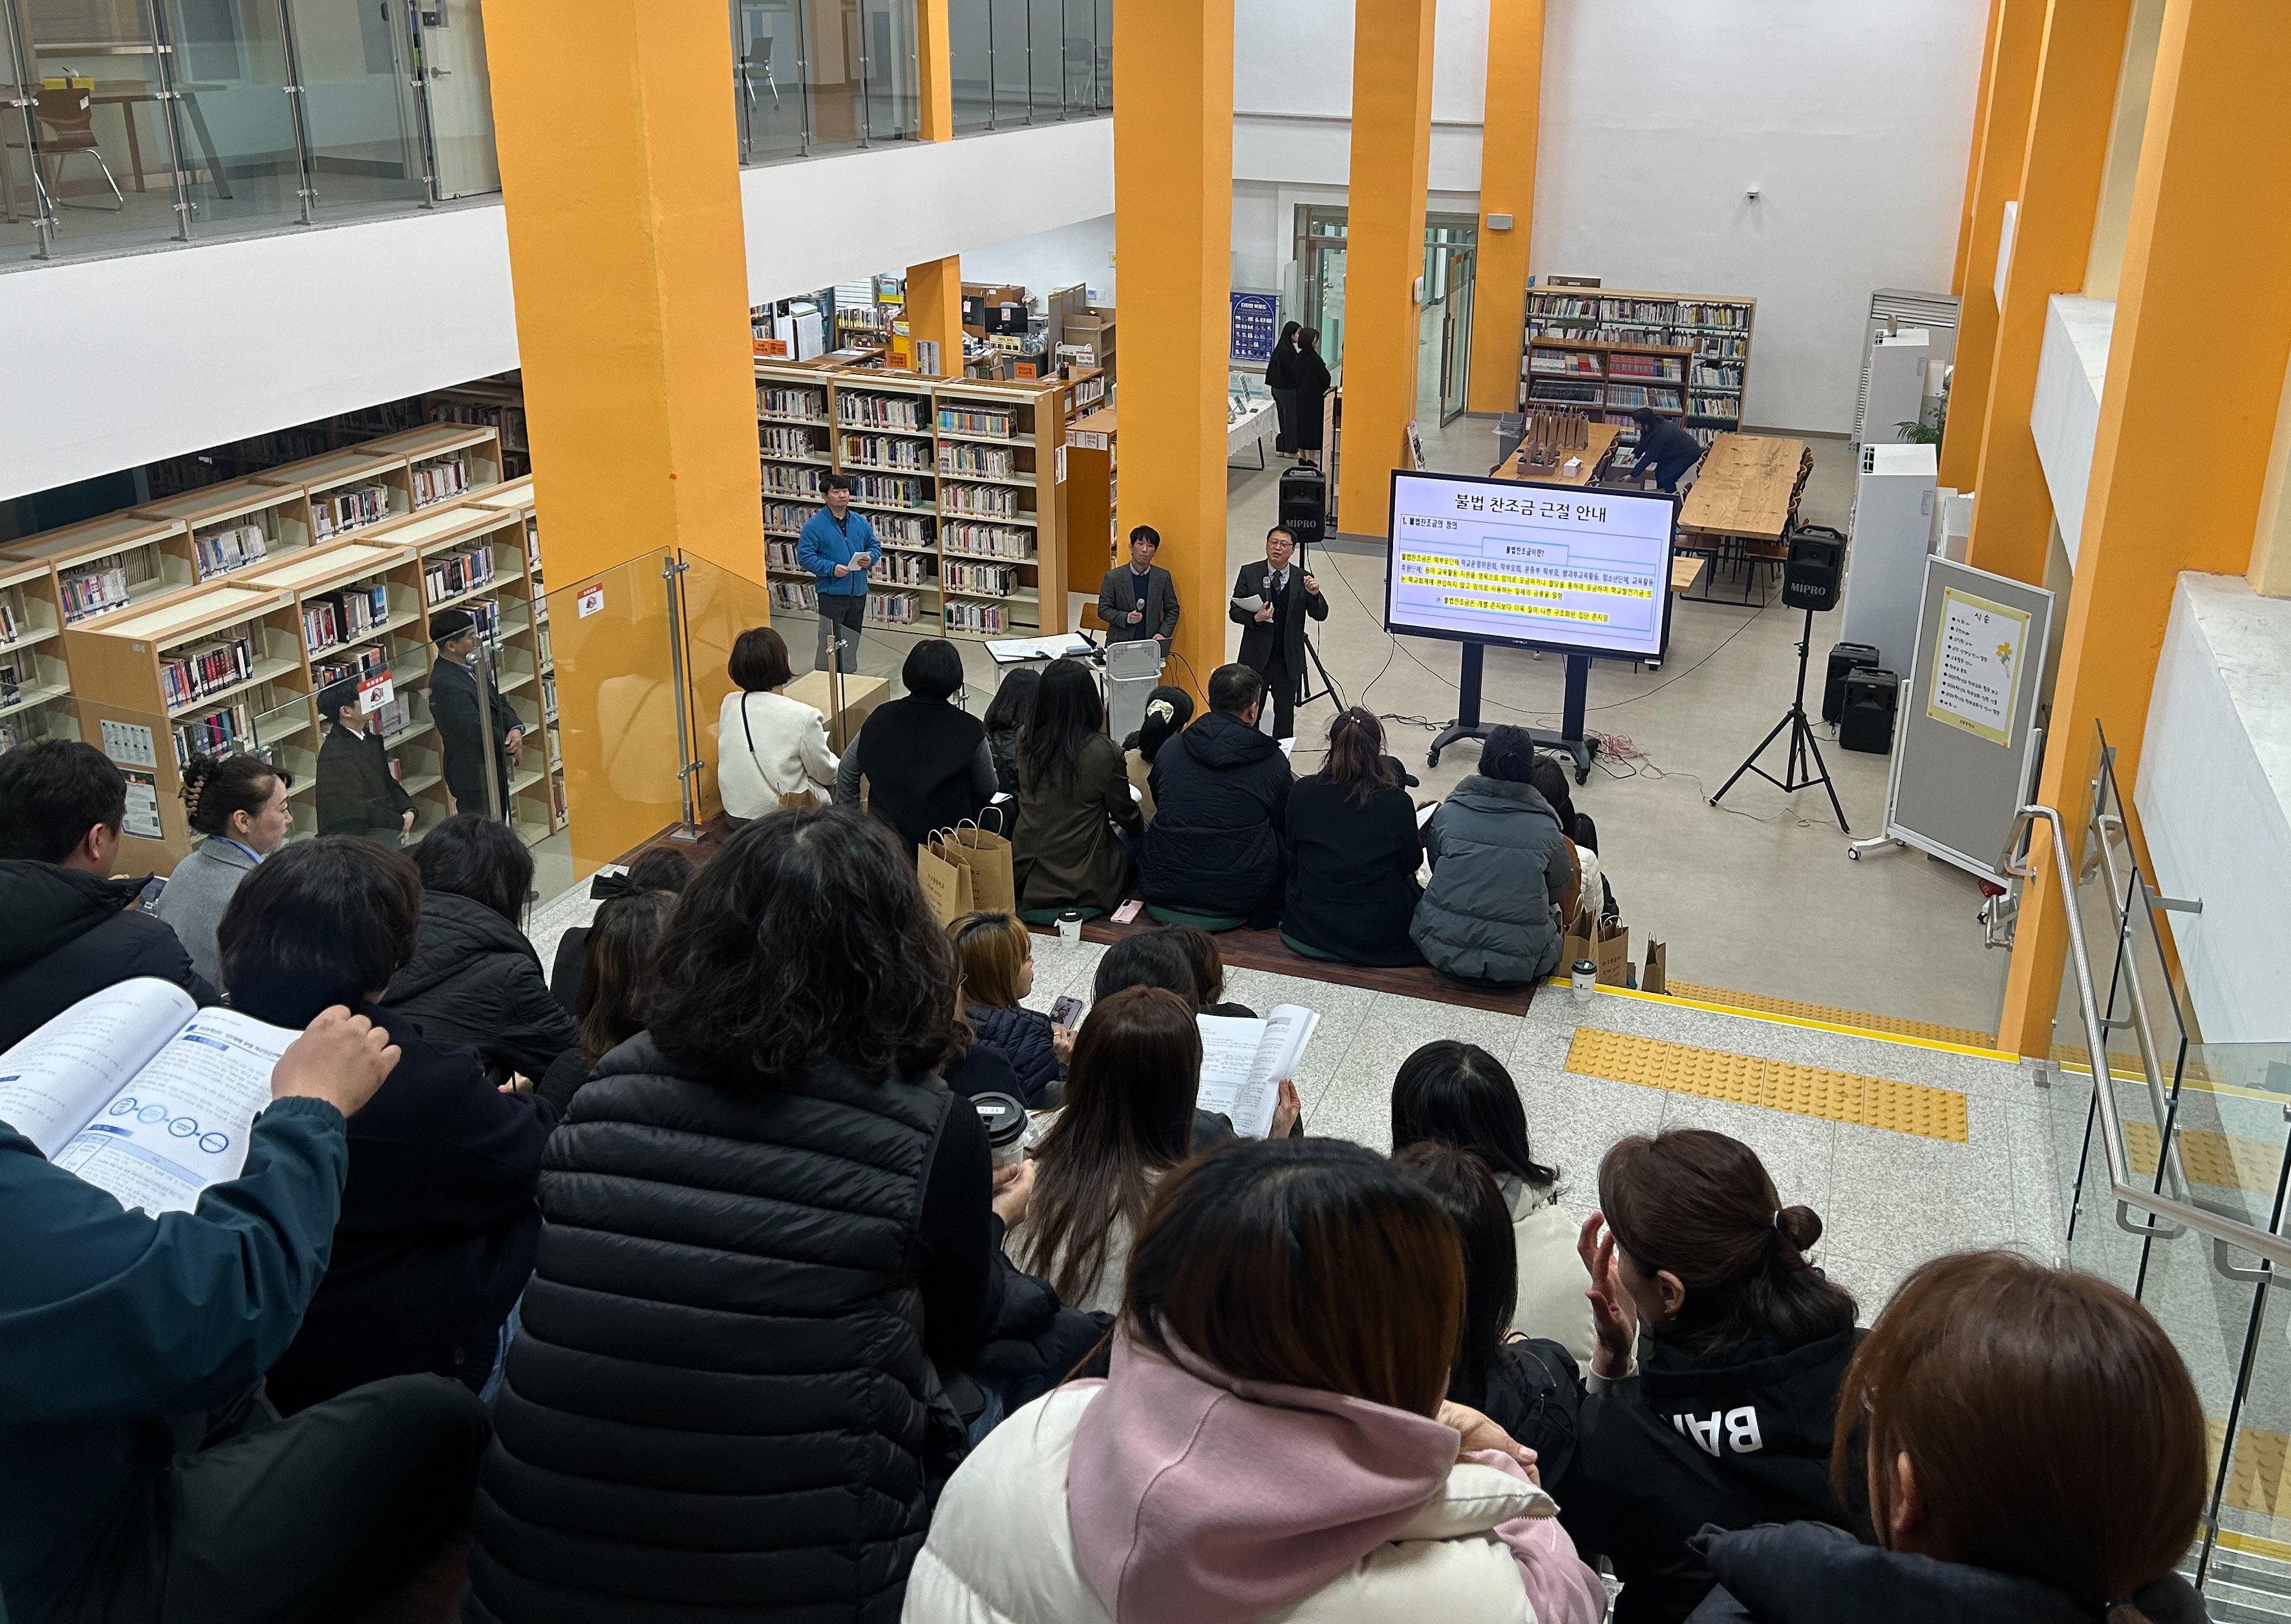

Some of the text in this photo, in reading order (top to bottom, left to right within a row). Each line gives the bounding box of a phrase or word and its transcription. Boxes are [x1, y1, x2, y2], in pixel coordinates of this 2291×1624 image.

[1231, 375, 1252, 384] BOK
[1455, 493, 1606, 523] 불법 찬조금 근절 안내
[1402, 517, 1458, 530] 1. 불법찬조금의 정의
[1506, 546, 1544, 557] 불법찬조금이란?
[1401, 553, 1431, 563] 불법찬조금은
[1632, 577, 1653, 587] 교육활동
[1444, 597, 1475, 606] 불법찬조금은
